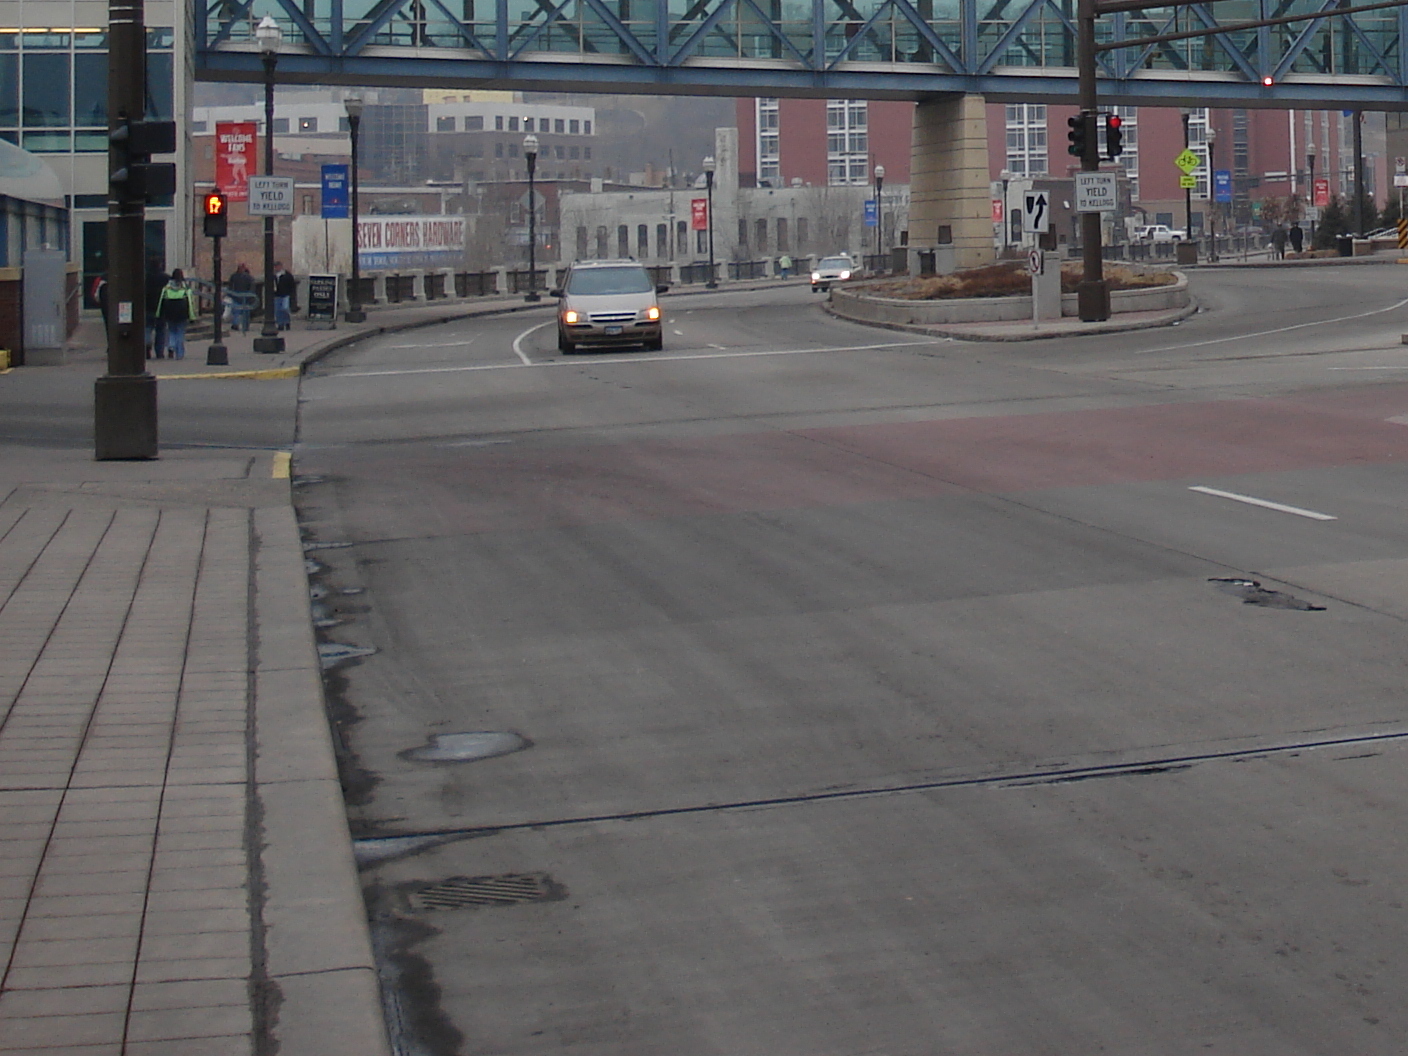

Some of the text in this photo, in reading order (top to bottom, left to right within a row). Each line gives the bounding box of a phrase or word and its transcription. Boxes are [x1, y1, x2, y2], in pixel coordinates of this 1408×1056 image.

[255, 181, 269, 189] LEFT
[1080, 177, 1094, 185] LEFT
[260, 191, 284, 201] YIELD
[1086, 187, 1107, 196] YIELD
[357, 221, 463, 248] SEVEN CORNERS HARDWARE
